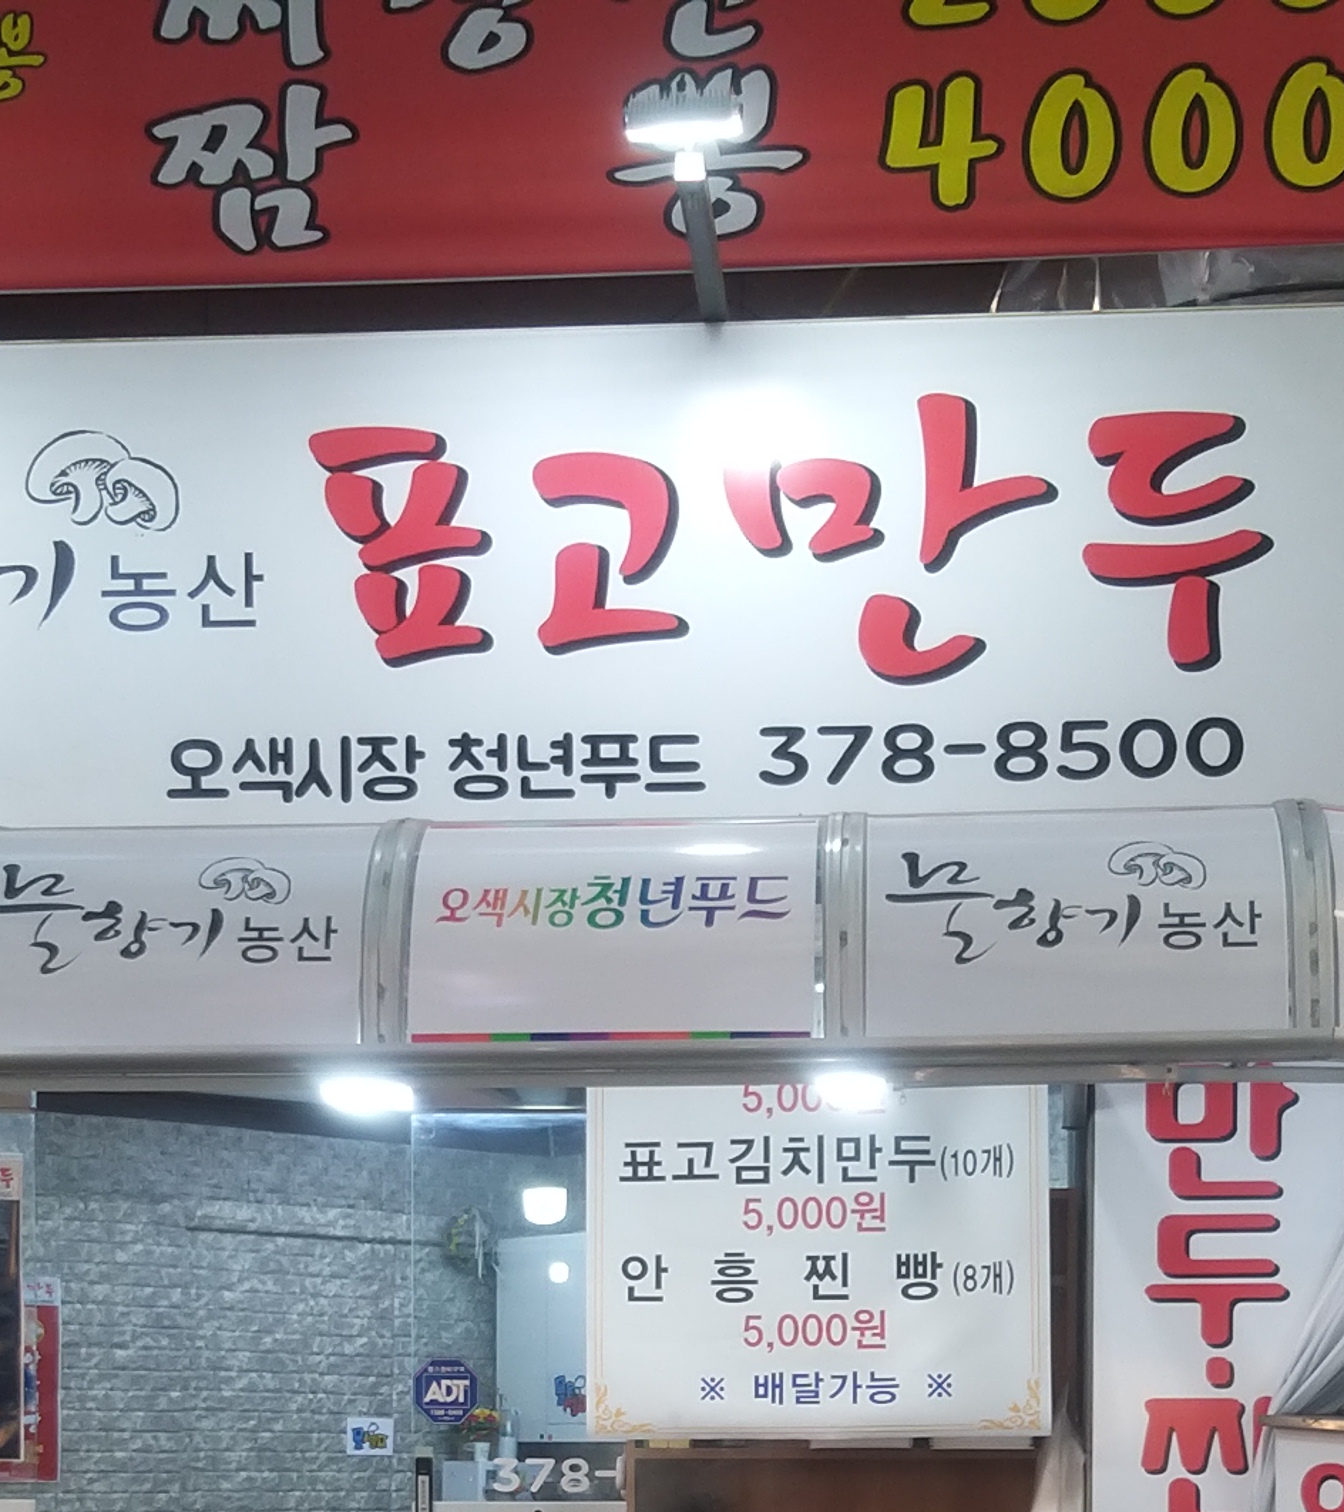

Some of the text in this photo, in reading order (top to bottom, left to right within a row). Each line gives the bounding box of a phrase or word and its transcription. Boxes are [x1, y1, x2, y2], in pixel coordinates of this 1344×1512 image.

[308, 392, 1273, 686] 표고만두
[166, 716, 1246, 802] 오색시장 청년푸드 378-8500
[742, 1191, 887, 1237] 5,000원
[742, 1309, 887, 1354] 5,000원
[424, 1379, 470, 1403] ADT
[754, 1371, 901, 1405] 배달가능
[493, 1457, 626, 1493] 378-
